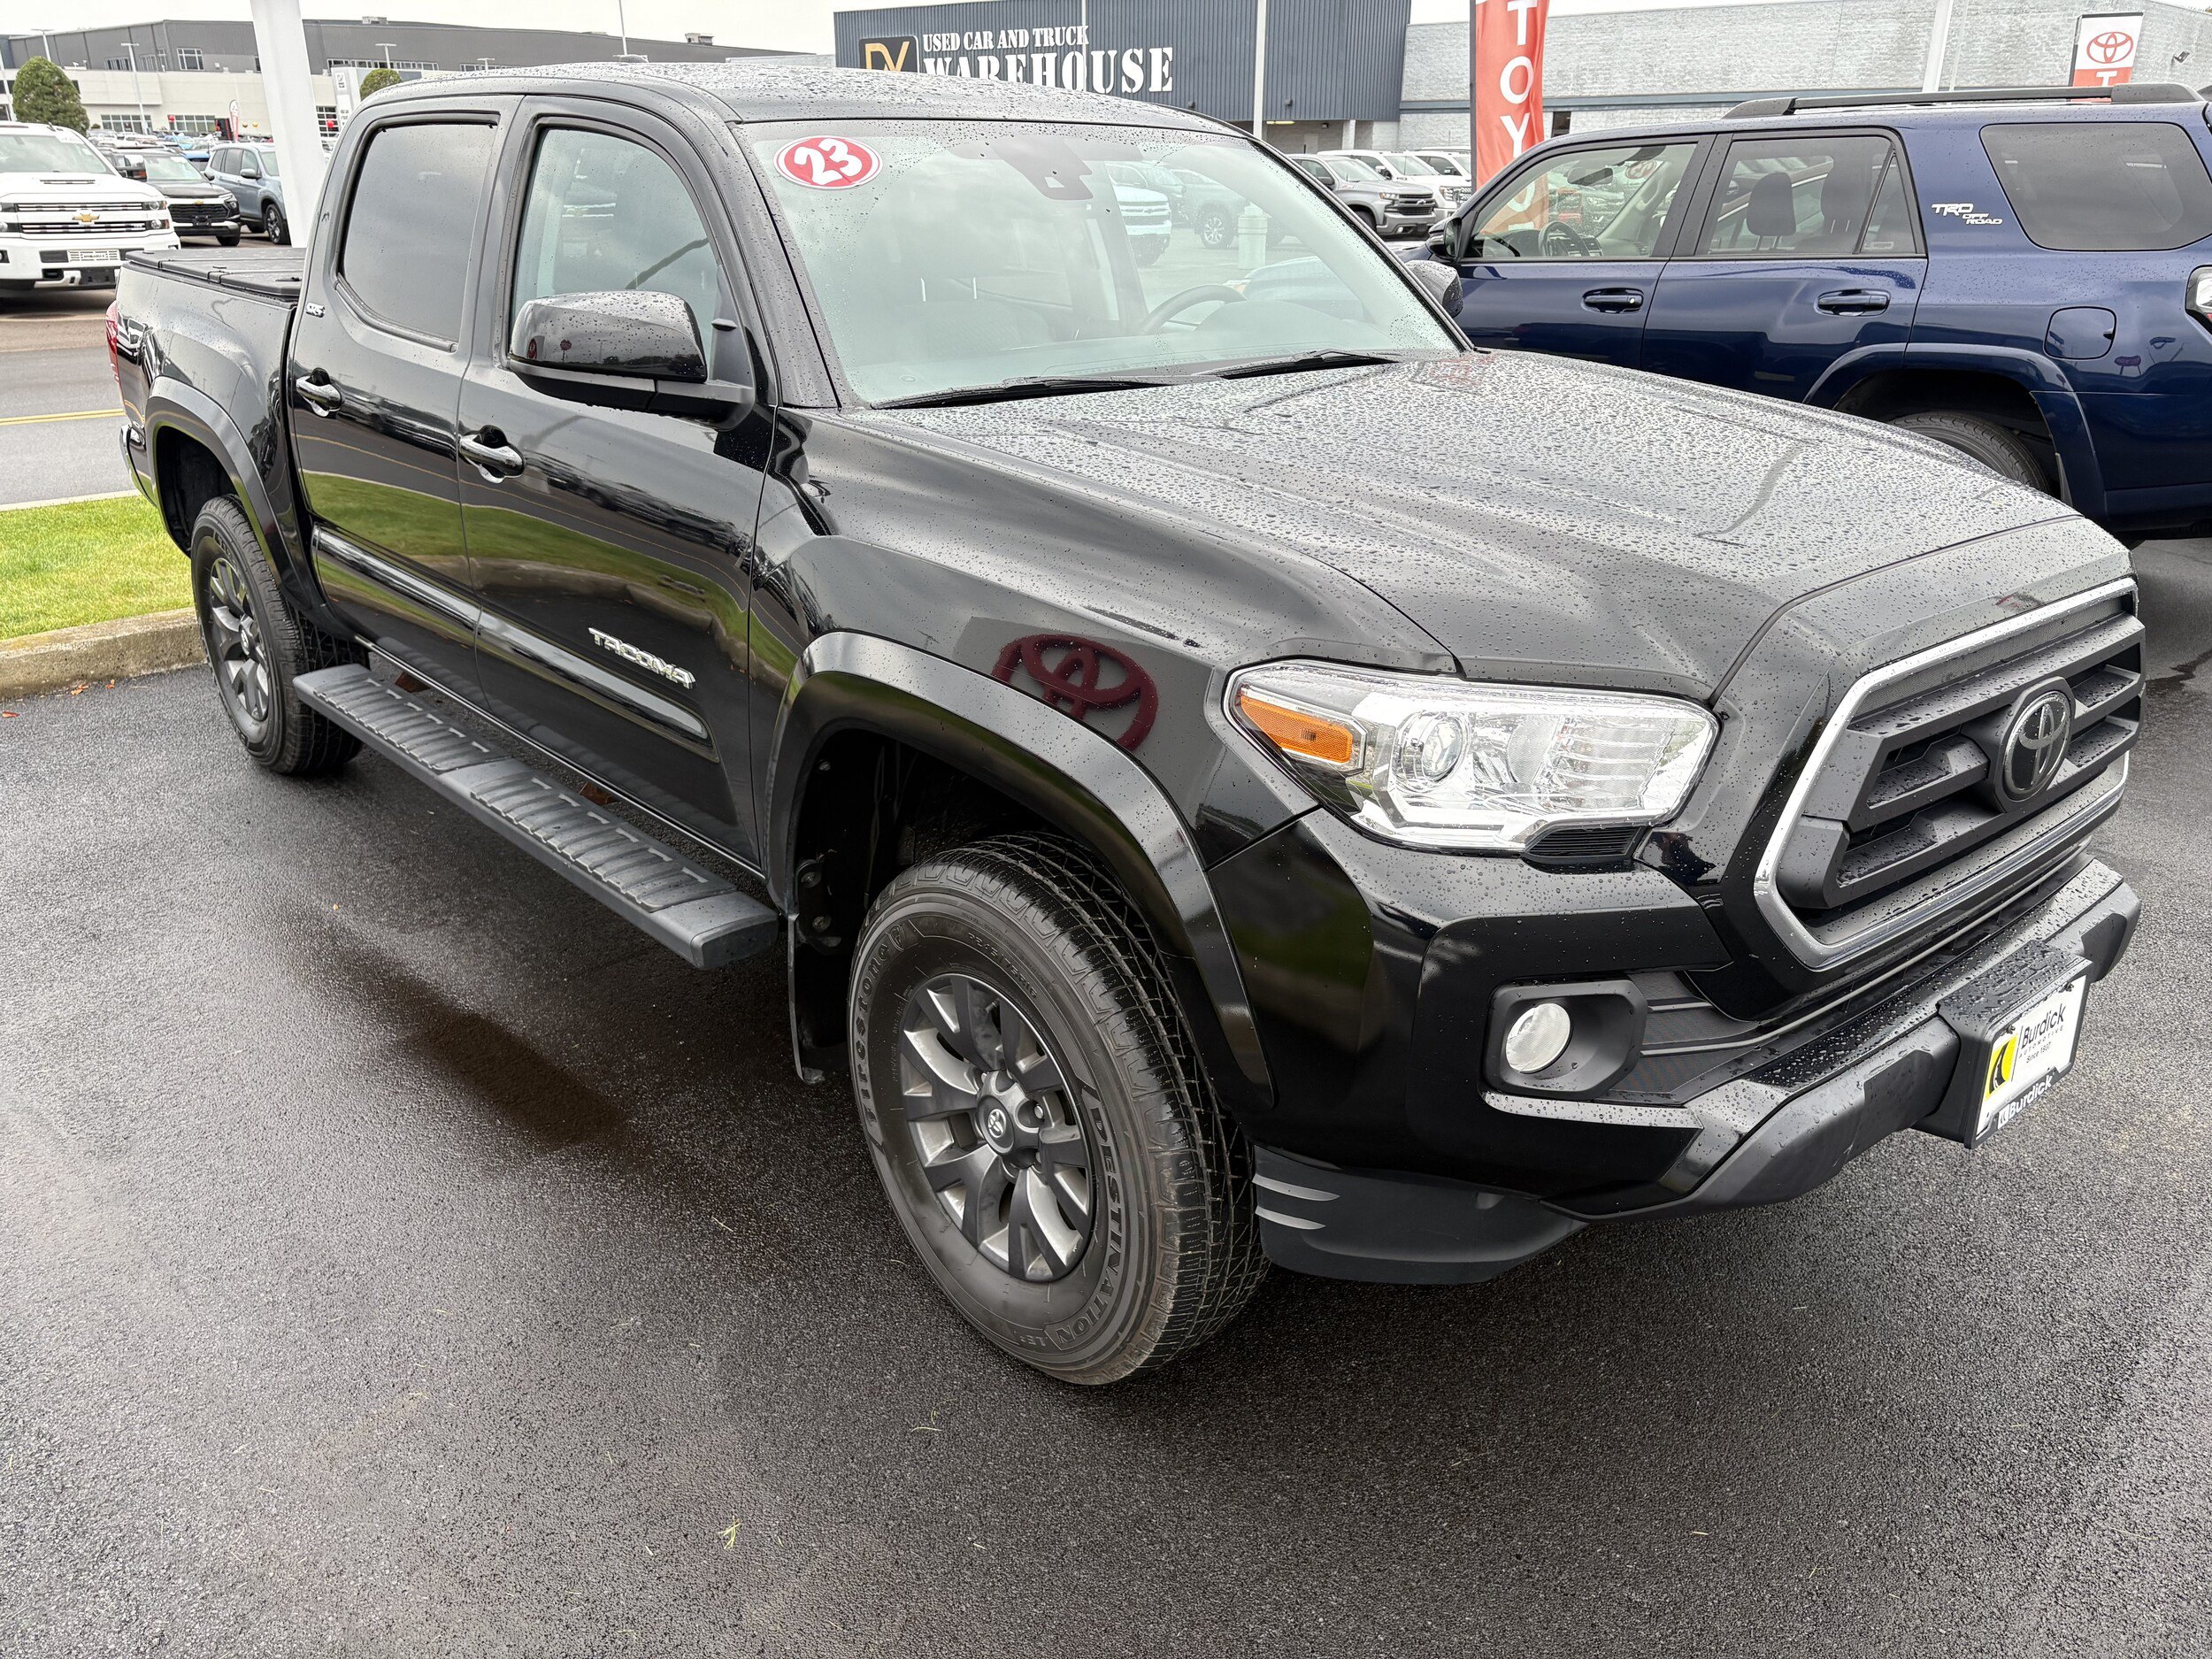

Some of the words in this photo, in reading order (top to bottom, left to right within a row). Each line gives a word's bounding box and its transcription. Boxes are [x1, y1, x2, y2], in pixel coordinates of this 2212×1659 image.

[923, 33, 960, 52] USED
[964, 31, 994, 50] CAR
[997, 29, 1029, 49] AND
[1033, 25, 1089, 47] TRUCK
[794, 138, 863, 186] 23
[1931, 203, 1974, 217] TRD
[588, 627, 695, 689] TACOMA
[2021, 1003, 2067, 1050] Burdick
[2008, 1074, 2053, 1119] Burdick
[1054, 1107, 1122, 1345] DESTINATION
